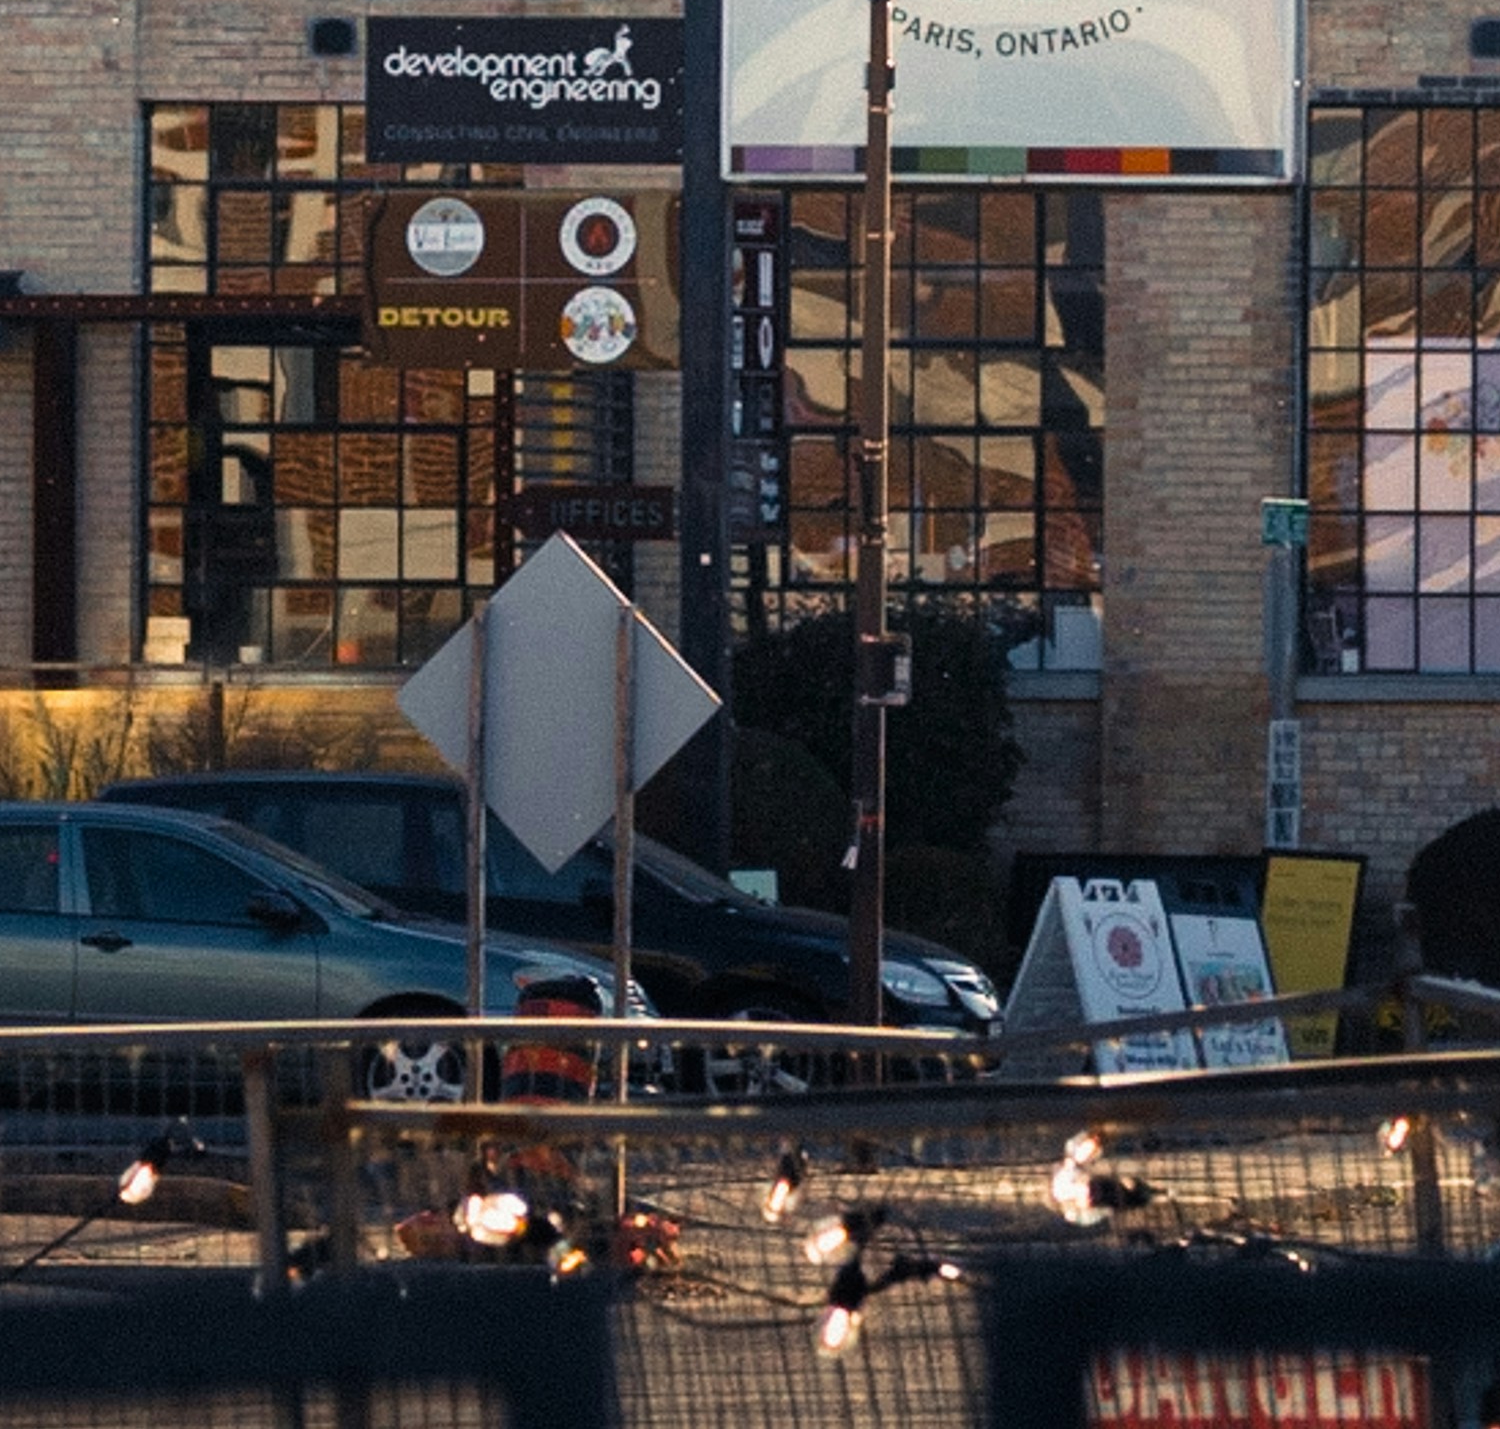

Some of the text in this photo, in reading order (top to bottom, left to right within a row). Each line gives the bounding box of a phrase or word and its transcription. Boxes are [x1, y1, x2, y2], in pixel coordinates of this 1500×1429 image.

[995, 9, 1131, 57] ONTARIO
[383, 45, 577, 84] development
[489, 77, 662, 110] engineering
[378, 307, 511, 328] DETOUR
